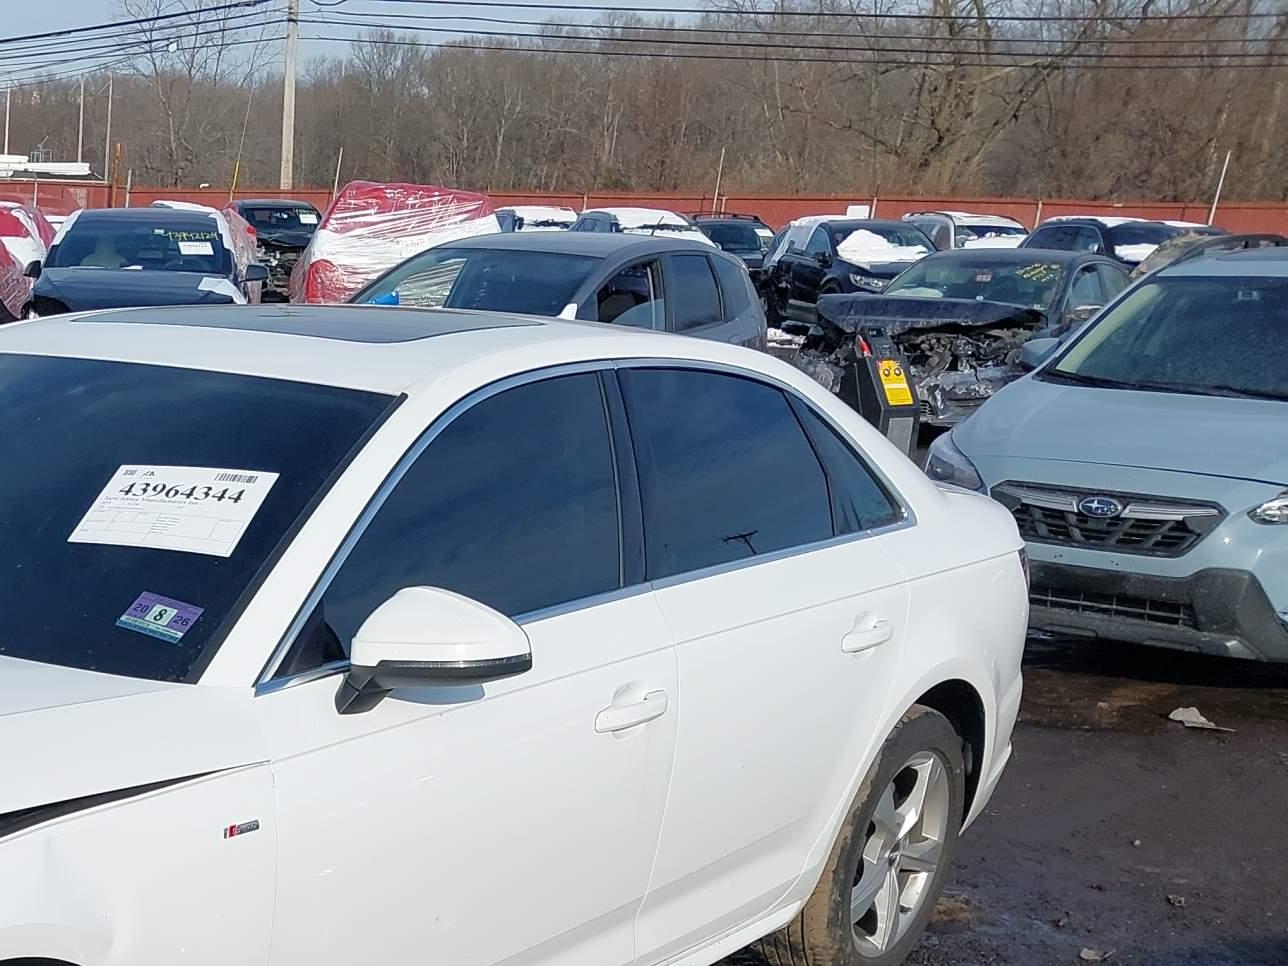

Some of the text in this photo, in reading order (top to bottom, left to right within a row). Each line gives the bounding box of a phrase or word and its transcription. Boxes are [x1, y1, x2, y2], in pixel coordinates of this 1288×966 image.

[119, 482, 246, 504] 43964344
[132, 602, 150, 614] 20
[153, 608, 168, 621] 8
[173, 615, 191, 627] 26
